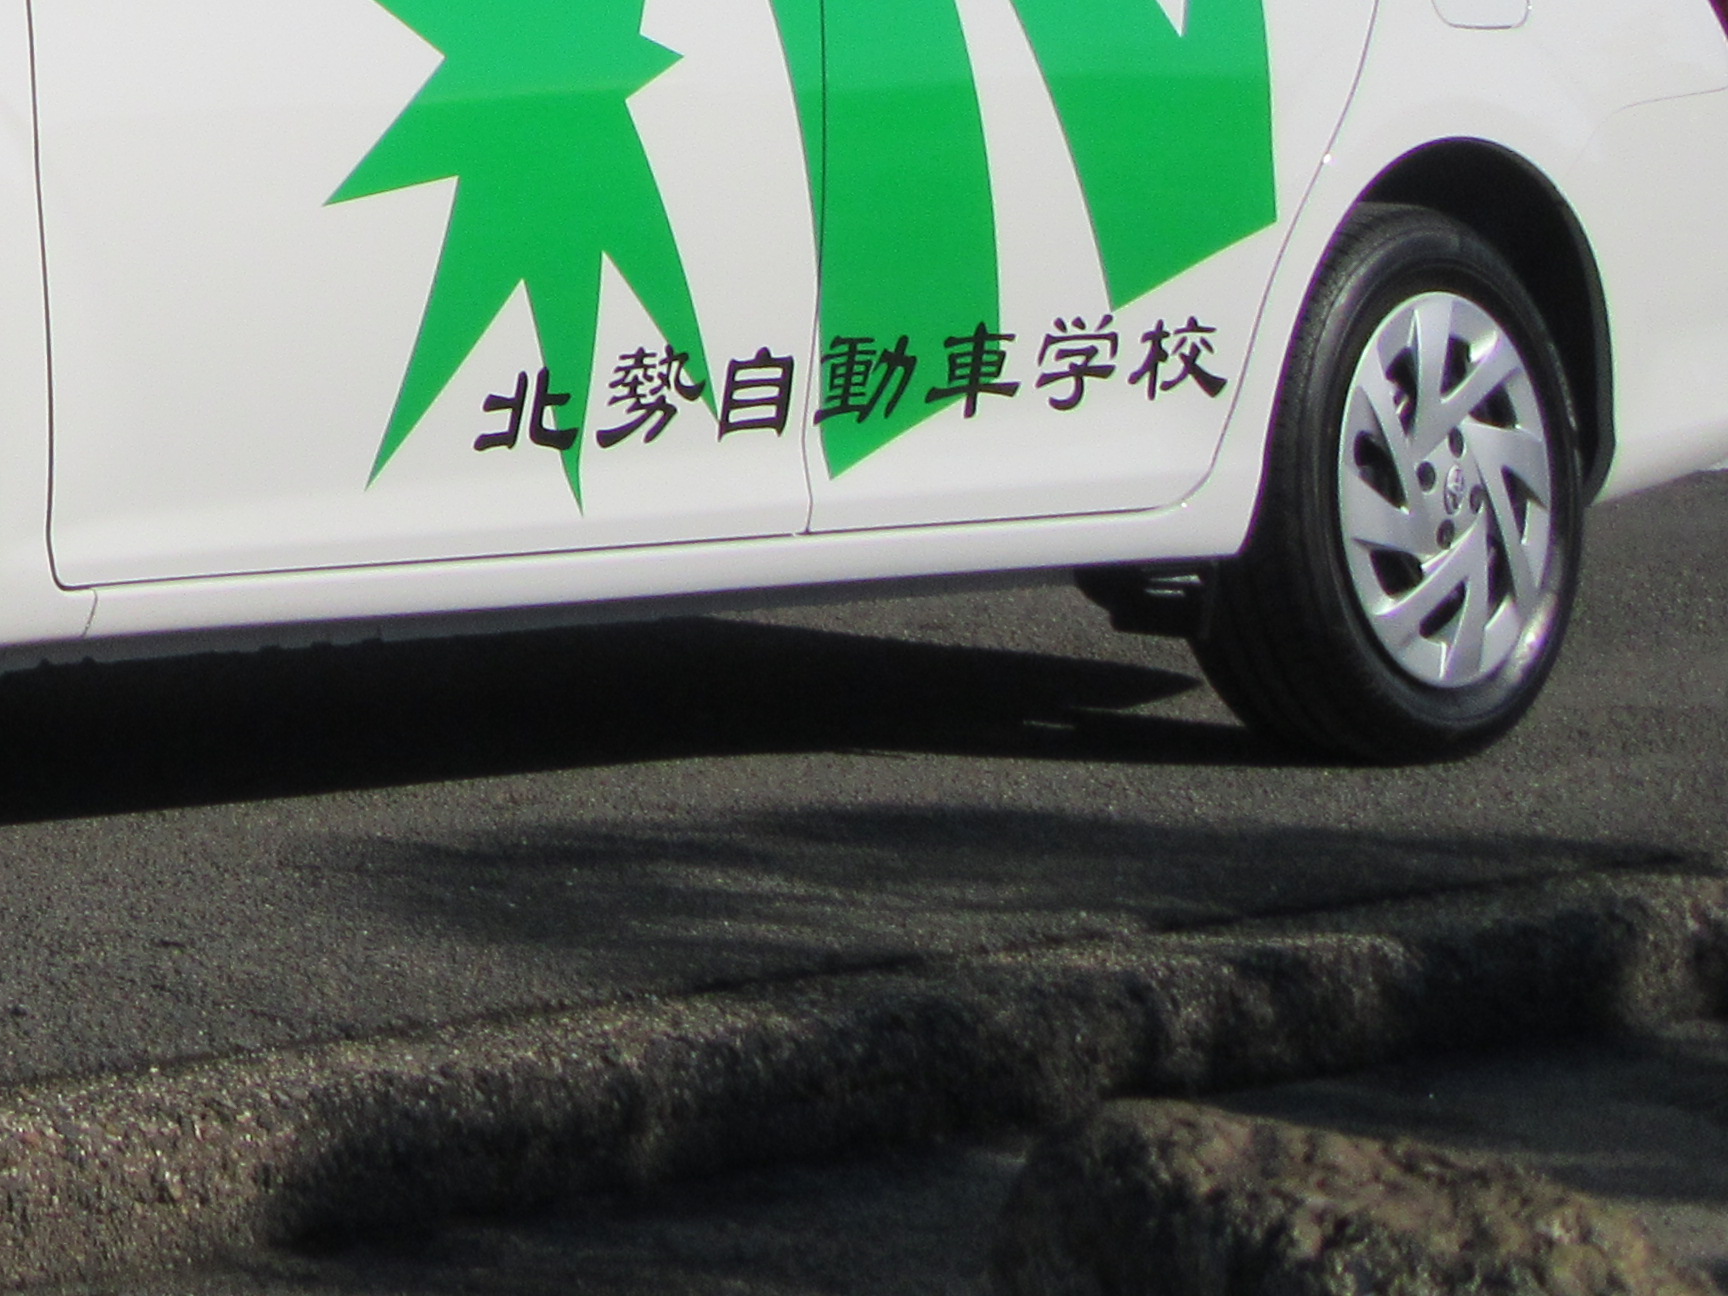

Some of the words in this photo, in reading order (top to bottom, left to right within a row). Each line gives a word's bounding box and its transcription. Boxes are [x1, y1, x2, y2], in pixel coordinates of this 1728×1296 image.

[473, 314, 1229, 452] 北勢自動車学校
